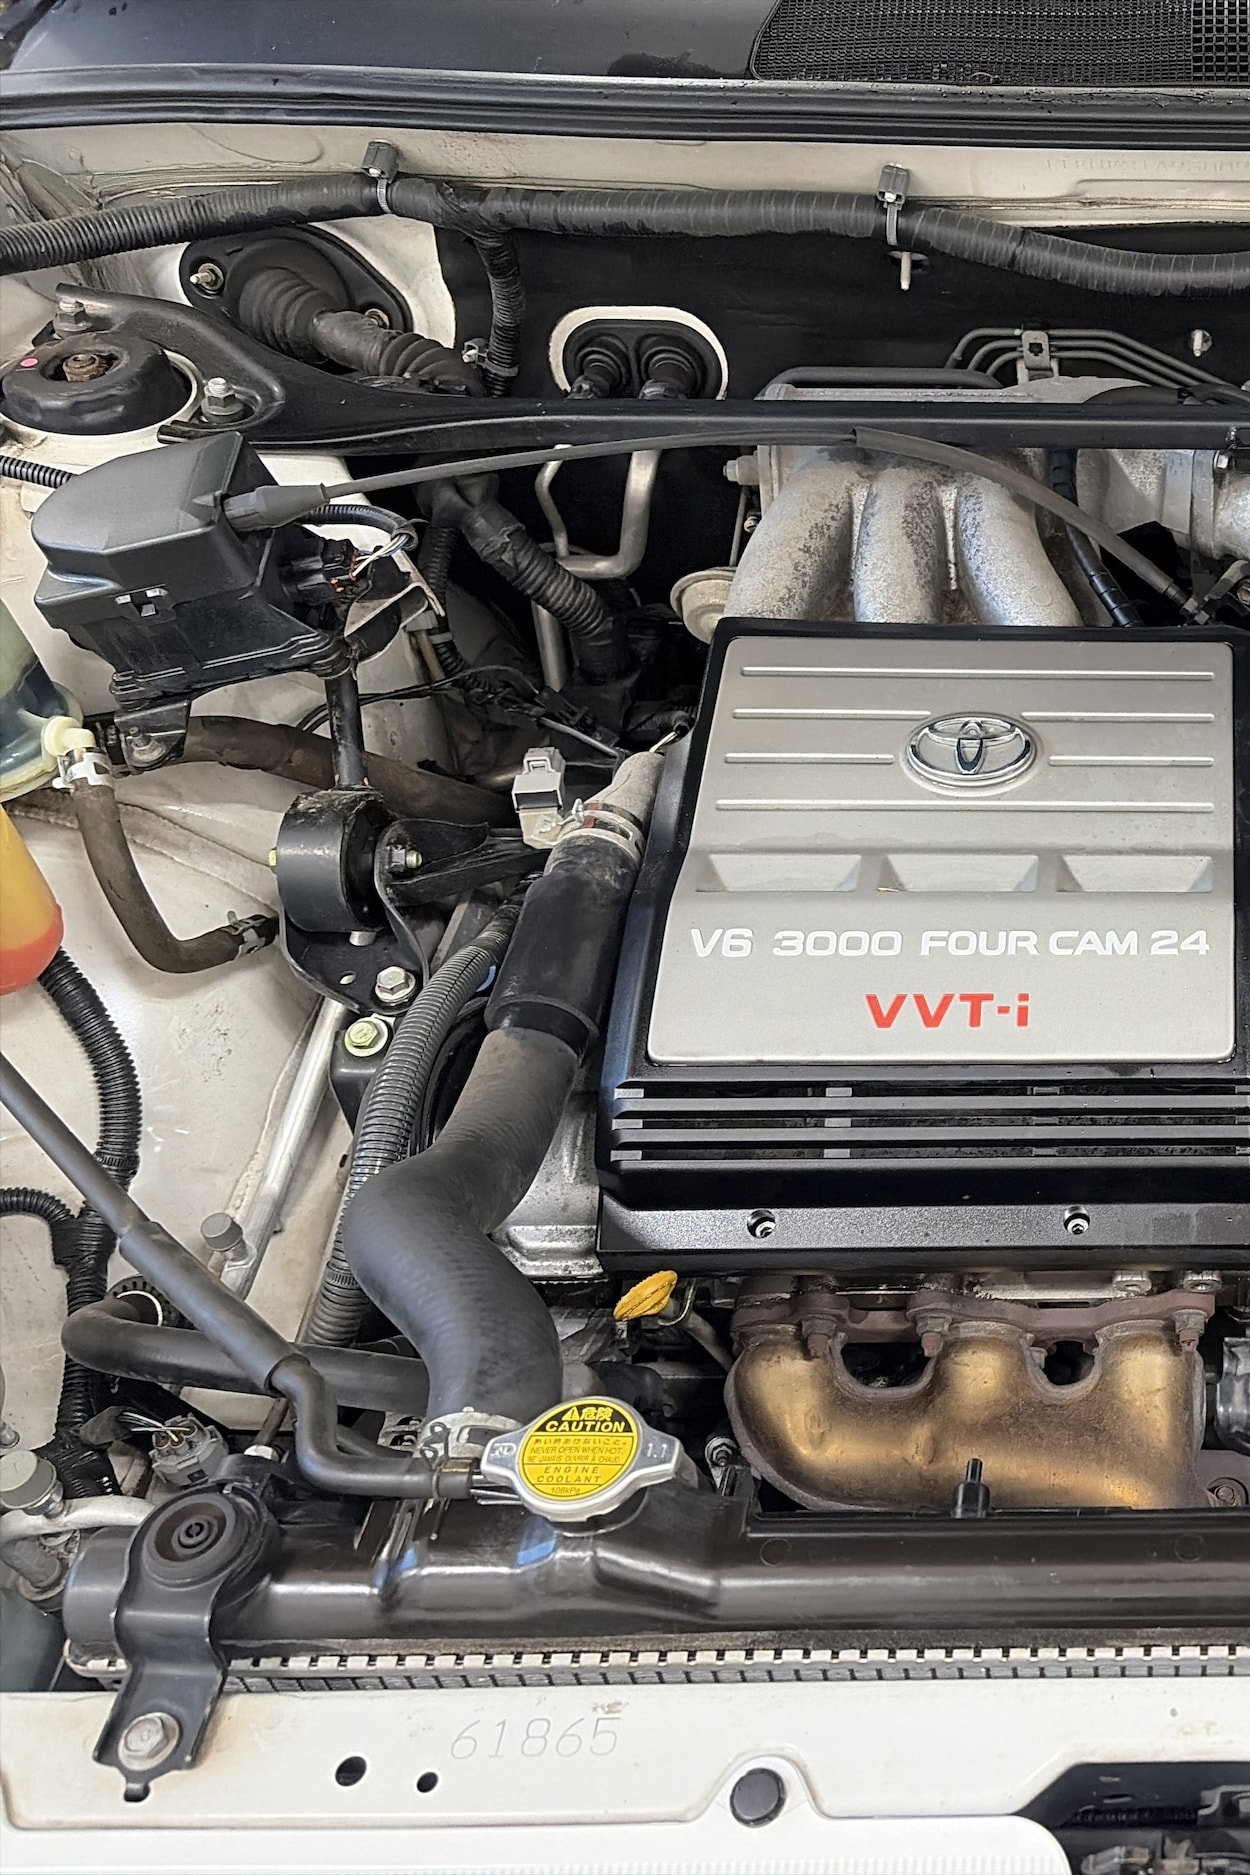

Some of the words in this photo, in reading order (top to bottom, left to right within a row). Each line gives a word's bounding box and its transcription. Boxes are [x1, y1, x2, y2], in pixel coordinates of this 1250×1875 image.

[690, 928, 753, 957] V6
[773, 929, 904, 957] 3000
[920, 929, 1040, 957] FOUR
[1049, 929, 1139, 956] CAM
[1150, 929, 1211, 956] 24
[864, 992, 1031, 1029] VVT-i
[580, 1406, 613, 1421] 危険
[545, 1420, 626, 1433] CAUTION
[530, 1446, 557, 1454] NEVER
[558, 1446, 580, 1454] OPEN
[581, 1446, 605, 1454] WHEN
[646, 1442, 668, 1459] 1.1
[544, 1466, 600, 1474] ENGINE
[537, 1475, 601, 1483] COOLANT
[450, 1716, 622, 1760] 61865
